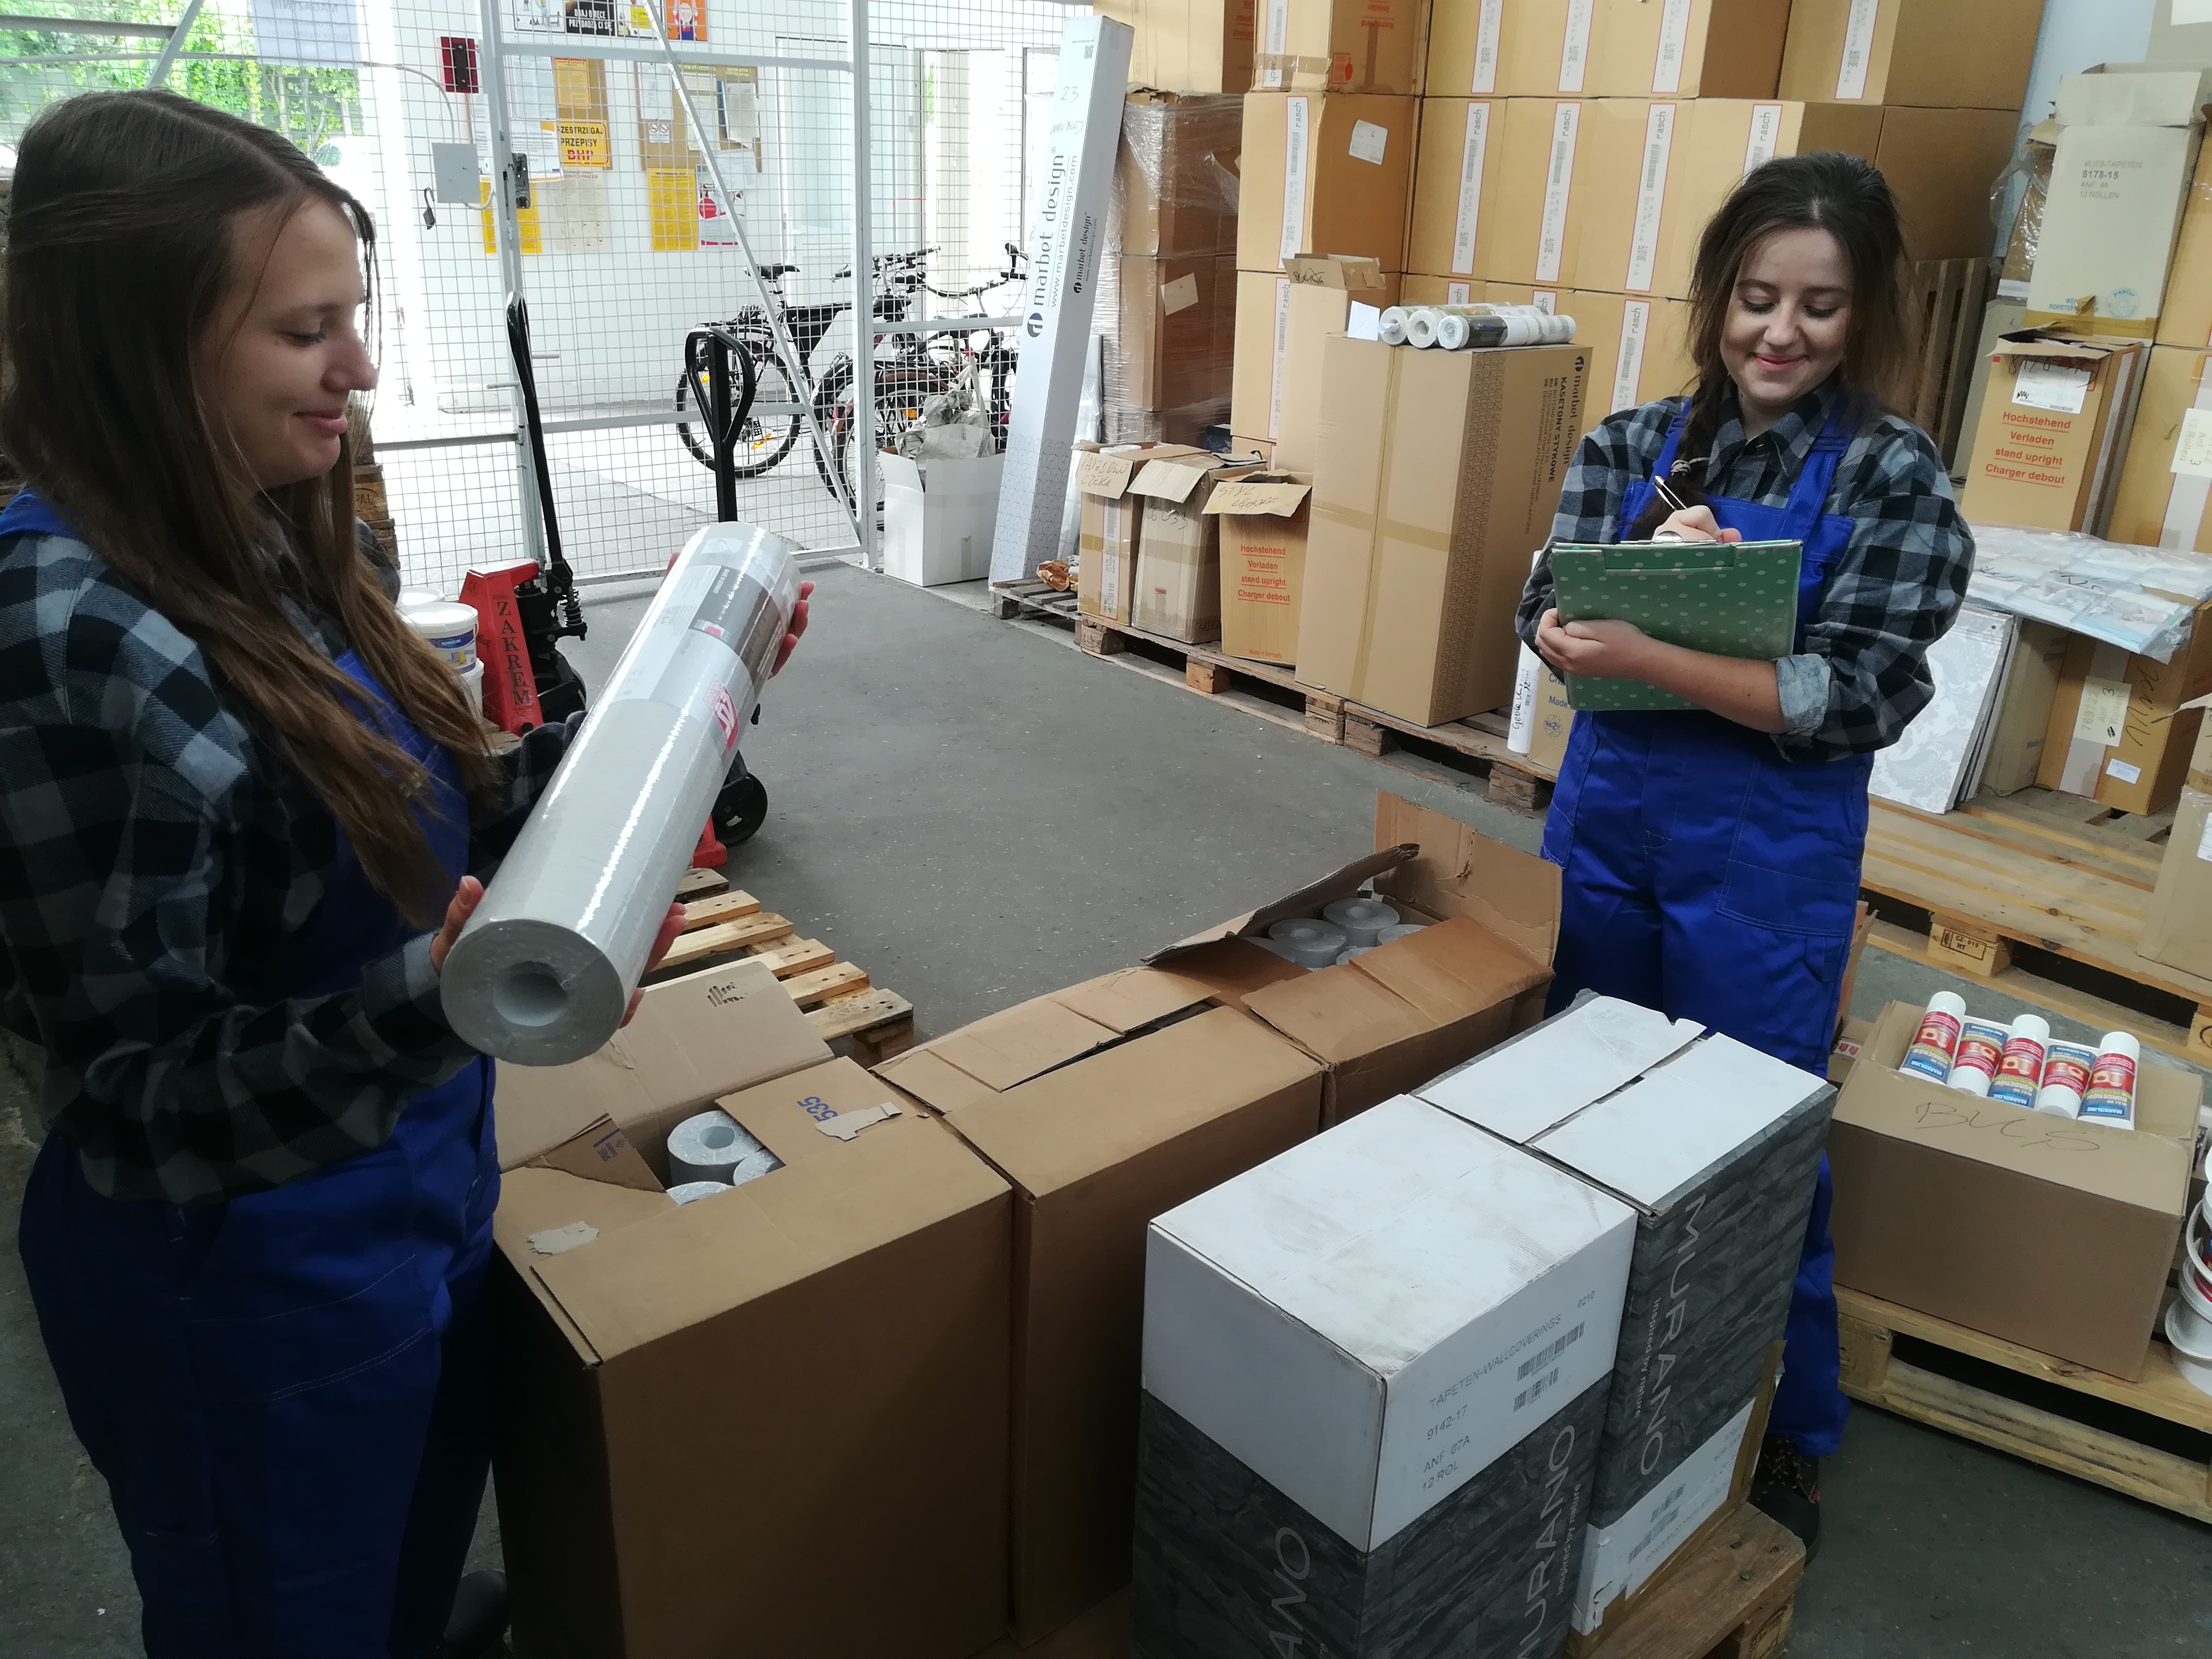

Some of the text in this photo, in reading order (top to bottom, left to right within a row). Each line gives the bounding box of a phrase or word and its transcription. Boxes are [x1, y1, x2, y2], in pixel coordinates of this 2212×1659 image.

[1060, 86, 1079, 103] 23
[557, 127, 603, 135] ZESTRZEGAJ
[1473, 109, 1482, 135] rasch
[1561, 110, 1571, 137] rasch
[1656, 111, 1666, 139] rasch
[1759, 112, 1770, 142] rasch
[561, 139, 597, 147] PRZEPISY
[567, 149, 594, 161] BHP
[2082, 169, 2118, 180] 8178-15
[1034, 155, 1066, 306] marbet design
[1052, 155, 1077, 307] www.marbetdesign.com
[1454, 289, 1463, 305] sch
[1631, 307, 1641, 334] rasch
[1549, 377, 1567, 483] KASETONY STYKOWE
[2002, 411, 2071, 429] Hochstehend
[2011, 431, 2054, 445] Verladen
[1995, 448, 2063, 466] stand upright
[1986, 464, 2065, 484] Charger debout
[1241, 545, 1286, 555] Hochstehend
[1248, 561, 1278, 570] Verladen
[1262, 578, 1286, 587] upright
[1238, 590, 1291, 602] Charger debout
[497, 601, 533, 706] ZAKREM
[1549, 696, 1568, 708] Made
[1641, 1194, 1706, 1476] MURANO
[1430, 1314, 1562, 1410] TAPETEN-WALLCOVERINGS
[1634, 1375, 1647, 1418] nature
[1427, 1404, 1468, 1440] 9142-17
[1422, 1461, 1459, 1491] 12 ROL
[1569, 1482, 1582, 1525] nature
